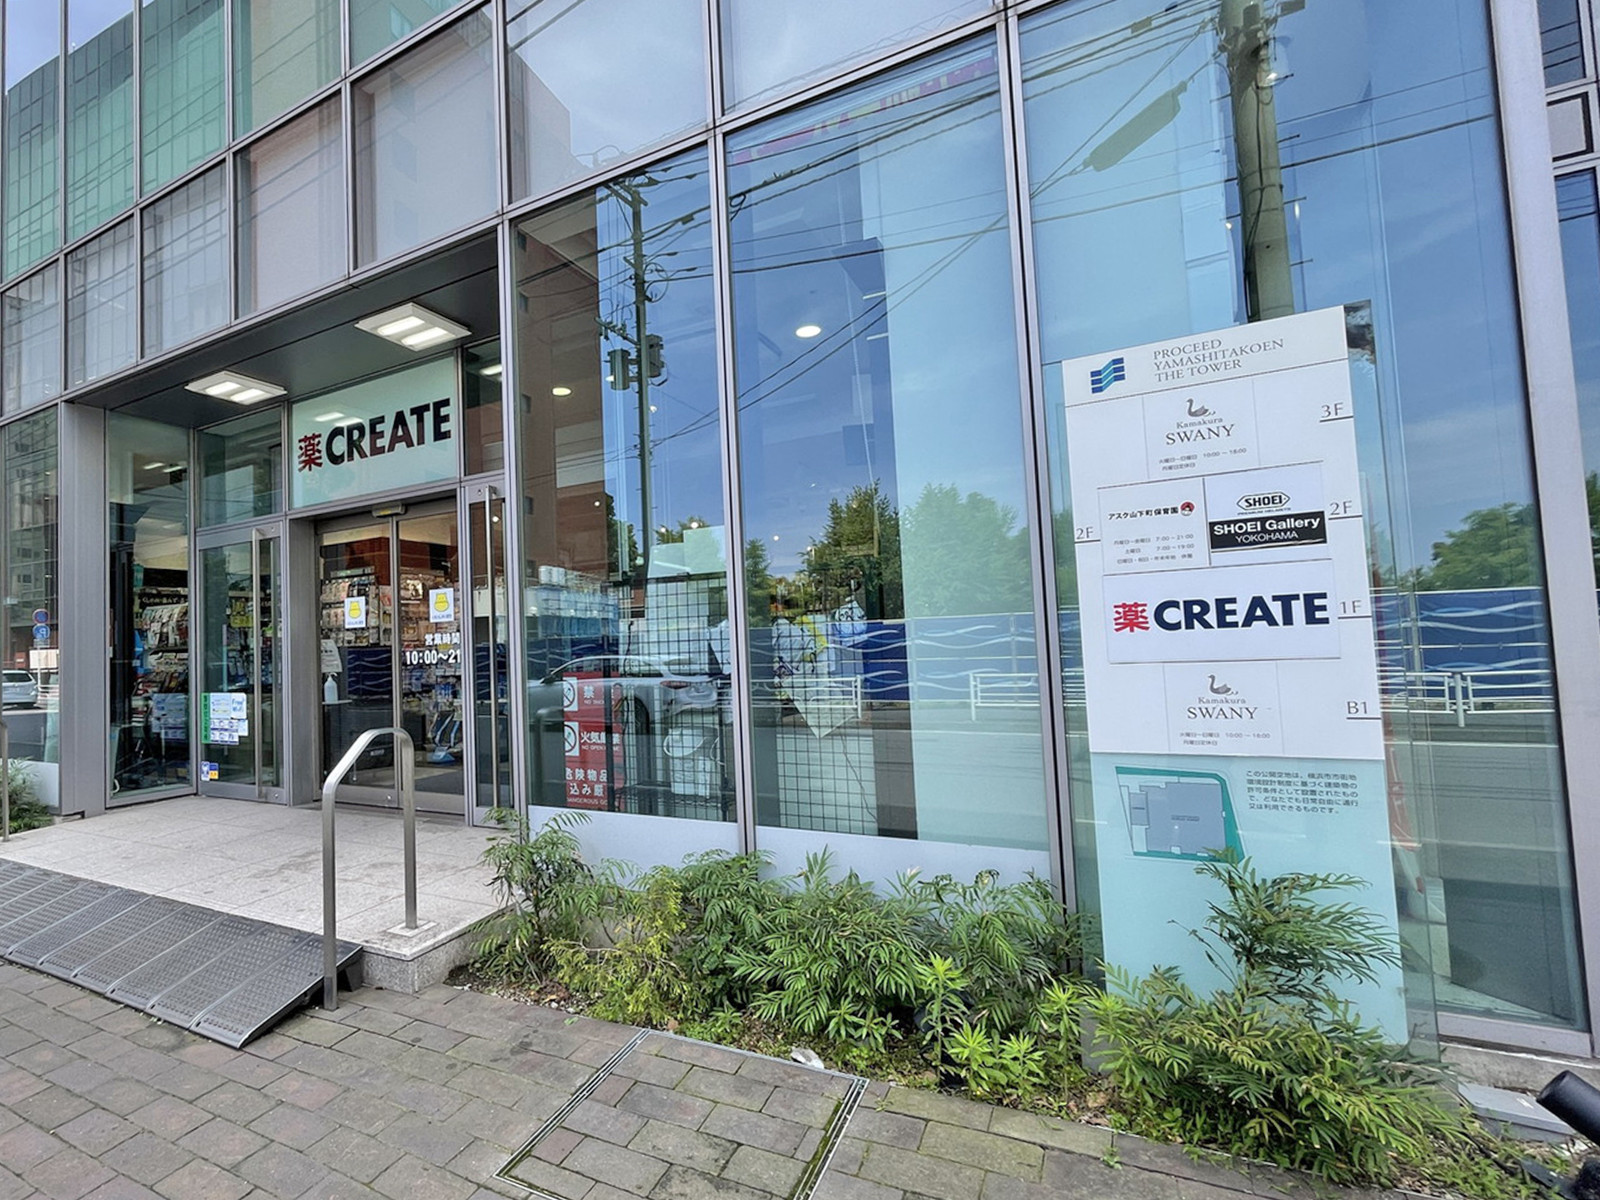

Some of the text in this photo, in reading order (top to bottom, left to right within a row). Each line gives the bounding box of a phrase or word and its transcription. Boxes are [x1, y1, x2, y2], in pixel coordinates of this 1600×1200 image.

[1153, 338, 1222, 360] PROCEED
[1154, 338, 1284, 371] YAMASHITAKOEN
[1155, 359, 1242, 382] THE TOWER
[1321, 402, 1344, 418] 3F
[1176, 417, 1223, 429] Kamakura
[297, 397, 451, 472] 薬 CREATE
[1165, 423, 1235, 446] SWANY
[1244, 494, 1282, 508] SHOEI
[1329, 500, 1352, 516] 2F
[1108, 506, 1179, 520] アスク山下町保育園
[1076, 526, 1094, 540] 2F
[1213, 517, 1320, 536] SHOEI Gallery
[1235, 530, 1299, 544] YOKOHAMA
[1113, 592, 1331, 633] 薬 CREATE
[1340, 600, 1362, 615] 1F
[1187, 706, 1258, 720] SWANY
[1346, 701, 1369, 716] B1
